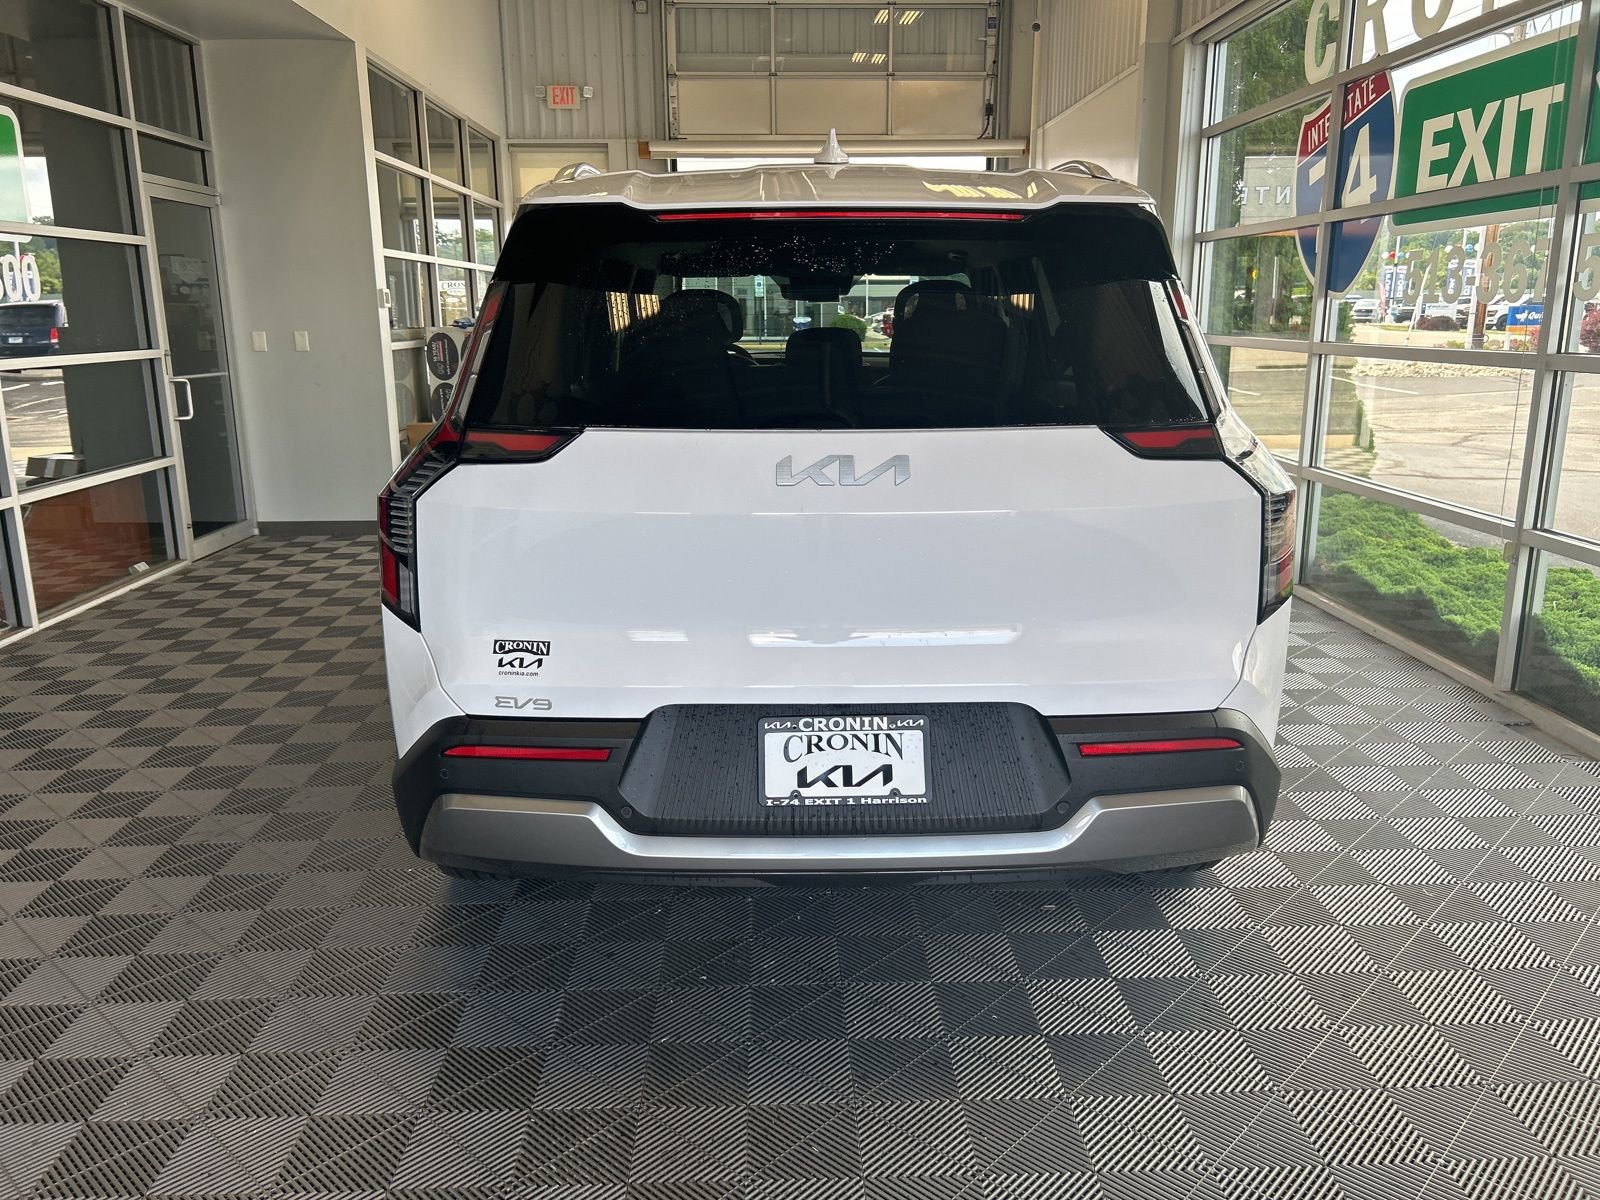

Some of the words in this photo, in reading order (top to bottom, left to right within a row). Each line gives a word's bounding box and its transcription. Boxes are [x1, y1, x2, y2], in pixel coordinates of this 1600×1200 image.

[552, 87, 576, 104] EXIT
[1307, 75, 1377, 152] INTETATE
[1416, 83, 1565, 193] EXIT
[776, 455, 911, 486] KIA
[495, 641, 549, 655] CRONIN
[498, 657, 543, 669] KIA
[495, 696, 552, 710] EV9
[799, 717, 888, 731] CRONIN
[783, 733, 905, 763] CRONIN
[797, 764, 893, 788] KIA
